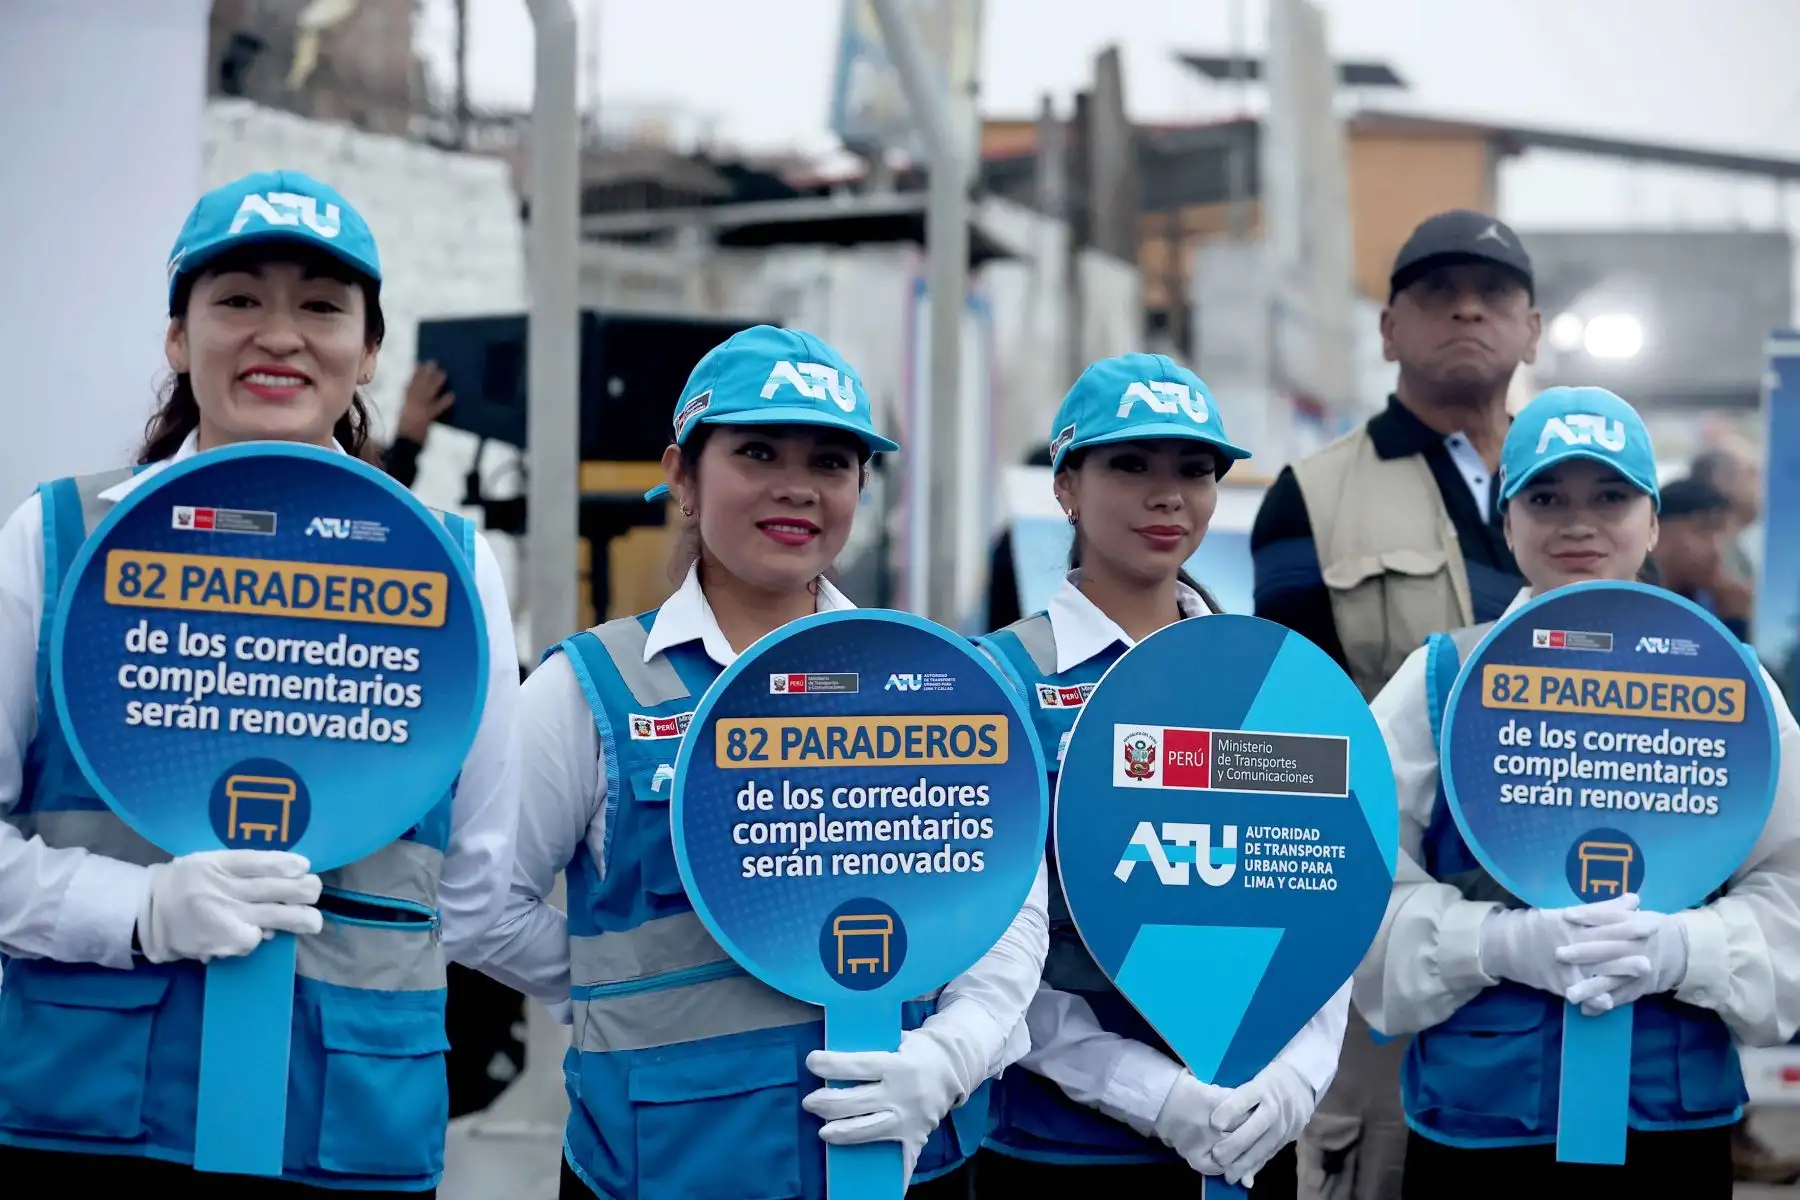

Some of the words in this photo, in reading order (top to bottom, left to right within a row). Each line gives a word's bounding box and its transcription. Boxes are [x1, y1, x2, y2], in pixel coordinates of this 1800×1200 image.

[228, 191, 341, 238] ATU
[759, 360, 857, 413] ATU
[1116, 379, 1209, 424] ATU
[1535, 413, 1626, 454] ATU
[304, 516, 351, 539] ATU
[118, 560, 167, 600] 82
[179, 565, 433, 619] PARADEROS
[125, 619, 169, 654] de
[178, 622, 226, 658] los
[235, 634, 420, 672] corredores
[1635, 636, 1670, 655] ATU
[118, 661, 421, 708] complementarios
[884, 673, 922, 691] ATU
[1061, 690, 1080, 701] PERÚ
[1491, 673, 1530, 704] 82
[1539, 675, 1735, 716] PARADEROS
[126, 697, 220, 730] serán
[229, 707, 408, 743] renovados
[656, 721, 676, 732] PERÚ
[726, 727, 769, 762] 82
[780, 723, 998, 761] PARADEROS
[1217, 738, 1273, 754] Ministerio
[1498, 719, 1532, 747] de
[1539, 721, 1577, 749] los
[1583, 728, 1726, 758] corredores
[1167, 747, 1204, 767] PERÚ
[1217, 753, 1232, 766] de
[1233, 753, 1297, 770] Transportes
[1493, 751, 1728, 787] complementarios
[1217, 769, 1224, 782] y
[1226, 768, 1314, 784] Comunicaciones
[736, 780, 774, 811] de
[783, 780, 824, 810] los
[832, 777, 990, 809] corredores
[1500, 780, 1573, 806] serán
[1580, 786, 1719, 815] renovados
[733, 811, 994, 851] complementarios
[1245, 826, 1320, 841] AUTORIDAD
[742, 848, 823, 878] serán
[832, 843, 985, 876] renovados
[1113, 821, 1238, 887] ATU
[1244, 859, 1298, 873] URBANO
[1301, 861, 1333, 874] PARA
[1245, 843, 1261, 855] DE
[1263, 843, 1346, 858] TRANSPORTE
[1244, 875, 1275, 888] LIMA
[1277, 876, 1286, 889] Y
[1288, 877, 1337, 890] CALLAO
